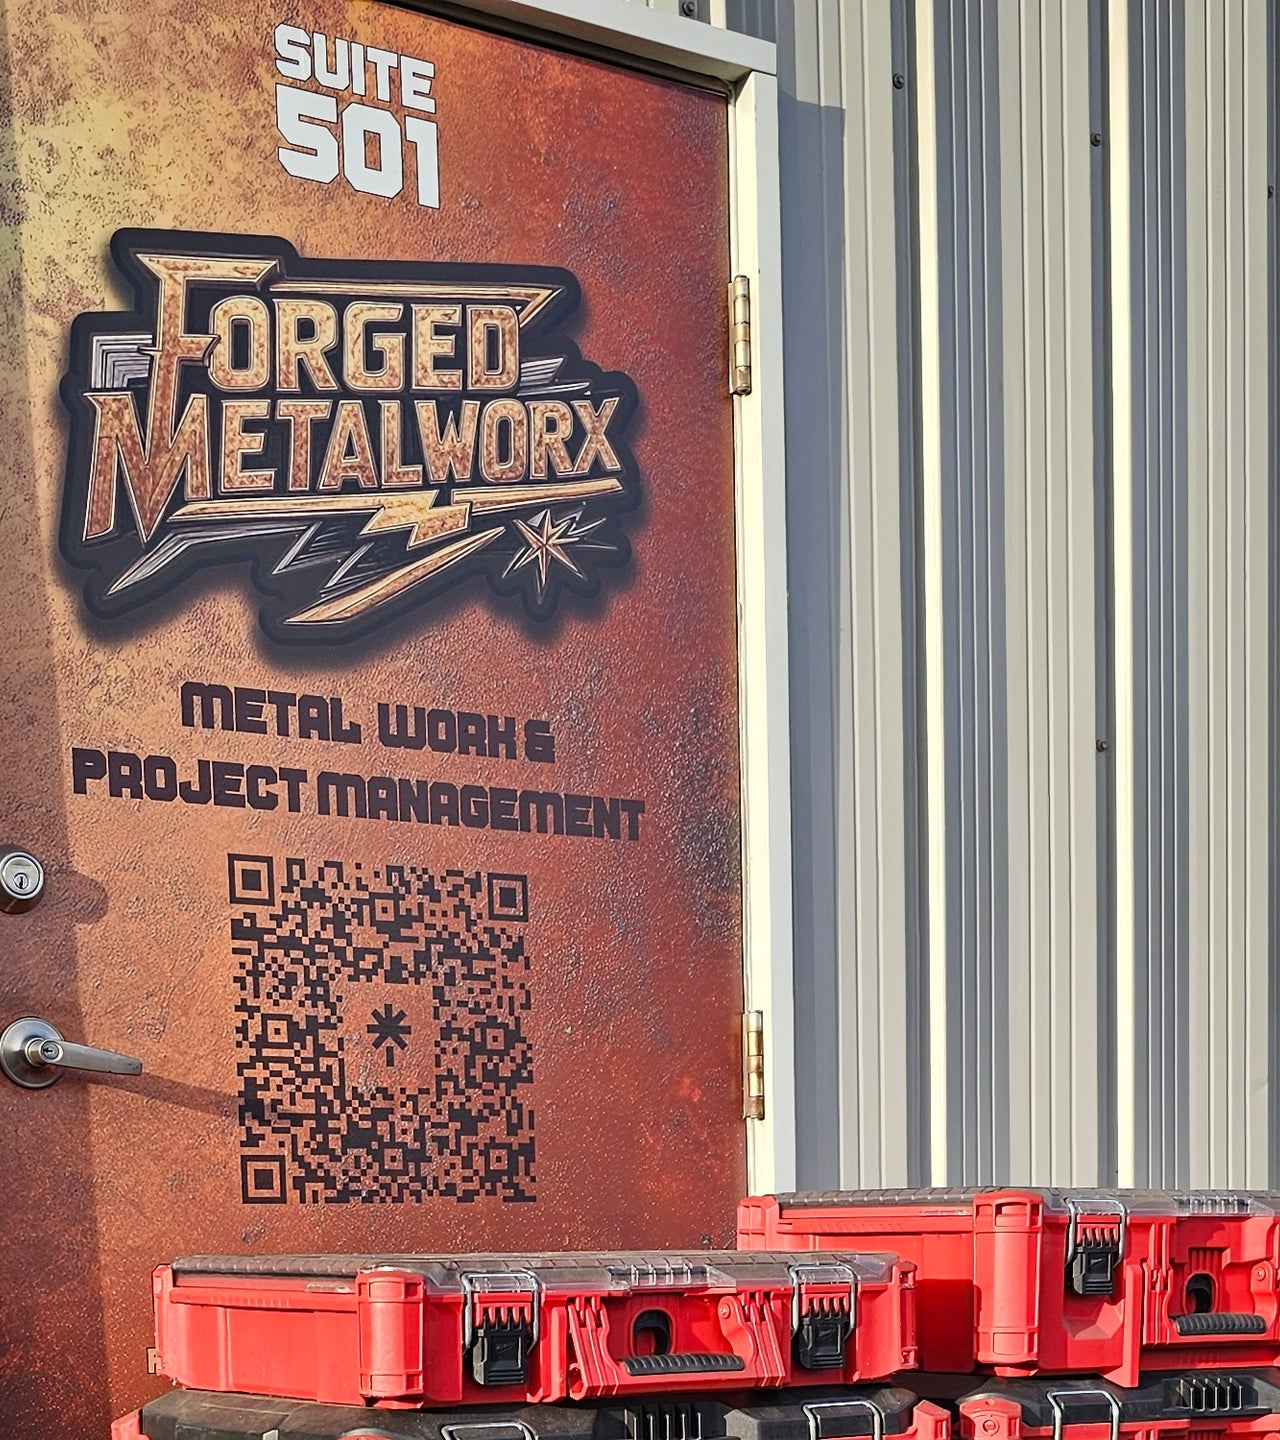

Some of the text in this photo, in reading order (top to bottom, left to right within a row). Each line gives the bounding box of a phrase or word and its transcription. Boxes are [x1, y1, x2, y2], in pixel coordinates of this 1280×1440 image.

[274, 23, 437, 115] SUITE
[274, 85, 441, 210] 501
[134, 252, 524, 430] FORGED
[82, 392, 624, 548] METALWORX
[180, 680, 556, 764] METAL WORK &
[71, 747, 646, 842] PROJECT MANAGEMENT
